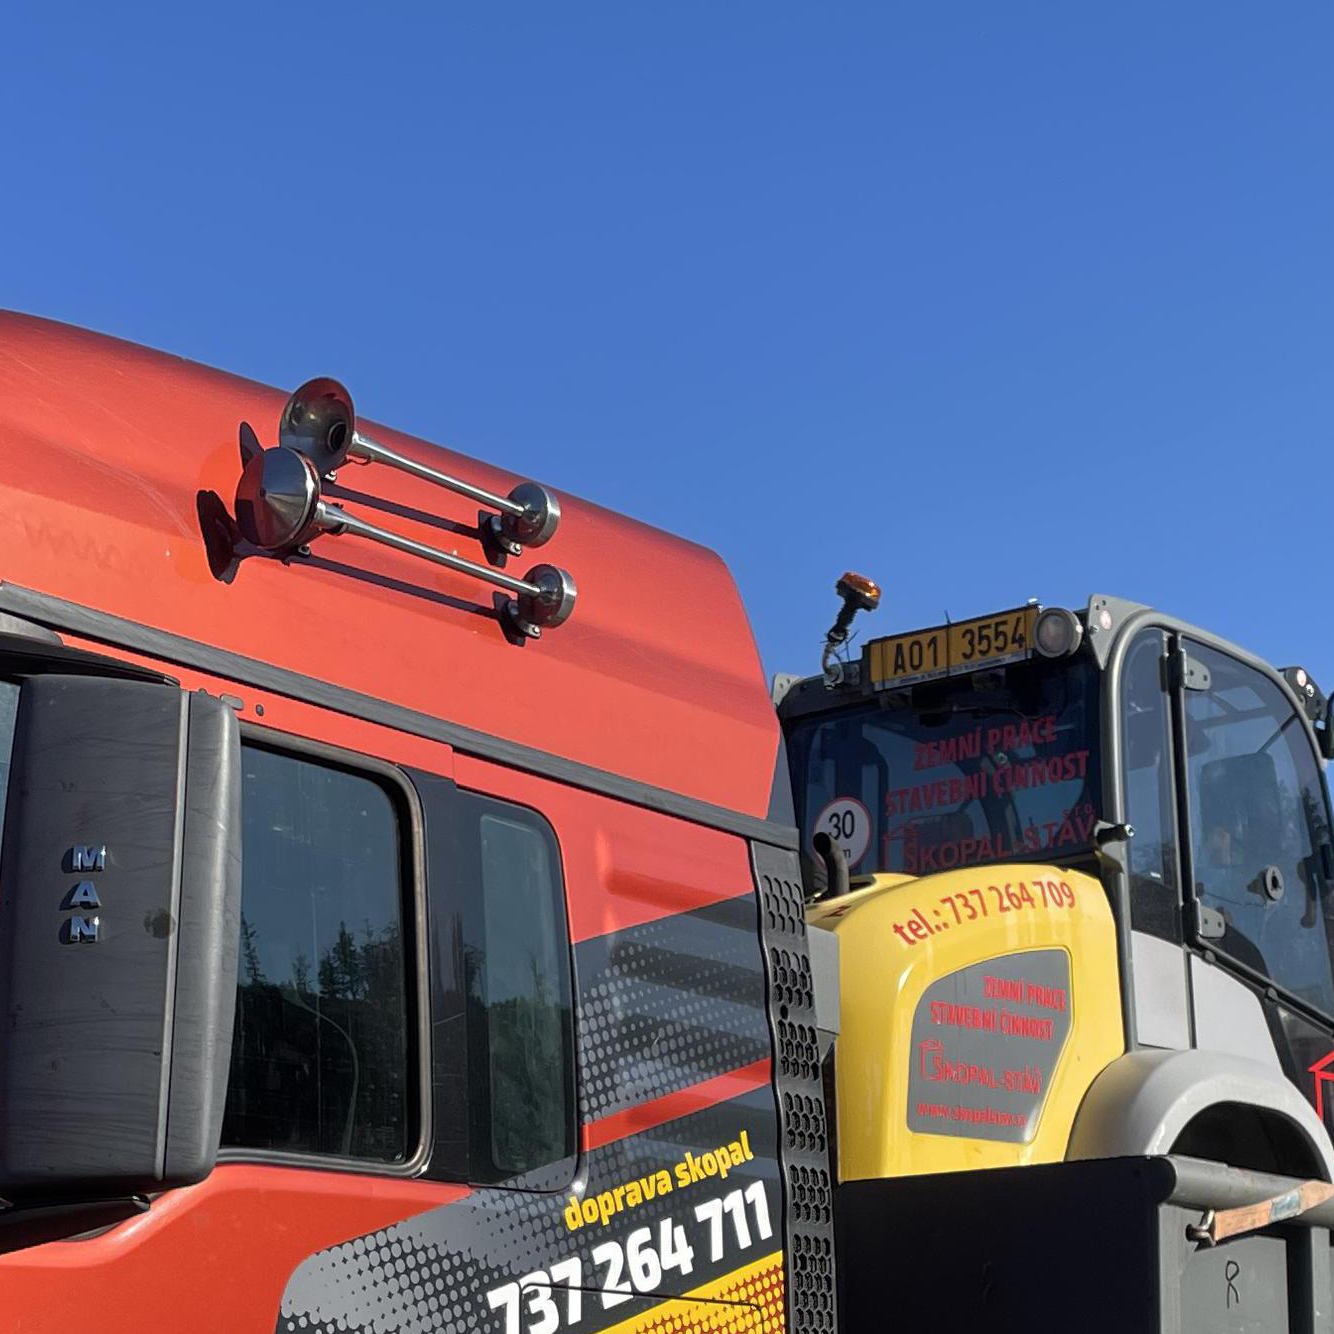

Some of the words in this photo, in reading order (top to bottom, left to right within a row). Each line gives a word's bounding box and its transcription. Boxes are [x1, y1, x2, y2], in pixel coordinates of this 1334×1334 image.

[893, 635, 938, 675] A01
[962, 616, 1027, 660] 3554
[829, 809, 855, 840] 30
[69, 844, 106, 942] MAN
[987, 881, 1036, 914] 264
[1032, 880, 1076, 909] 709
[564, 1169, 673, 1231] doprava
[674, 1130, 754, 1188] skopal
[591, 1217, 694, 1310] 264
[694, 1180, 773, 1263] 711
[1225, 1260, 1240, 1309] R
